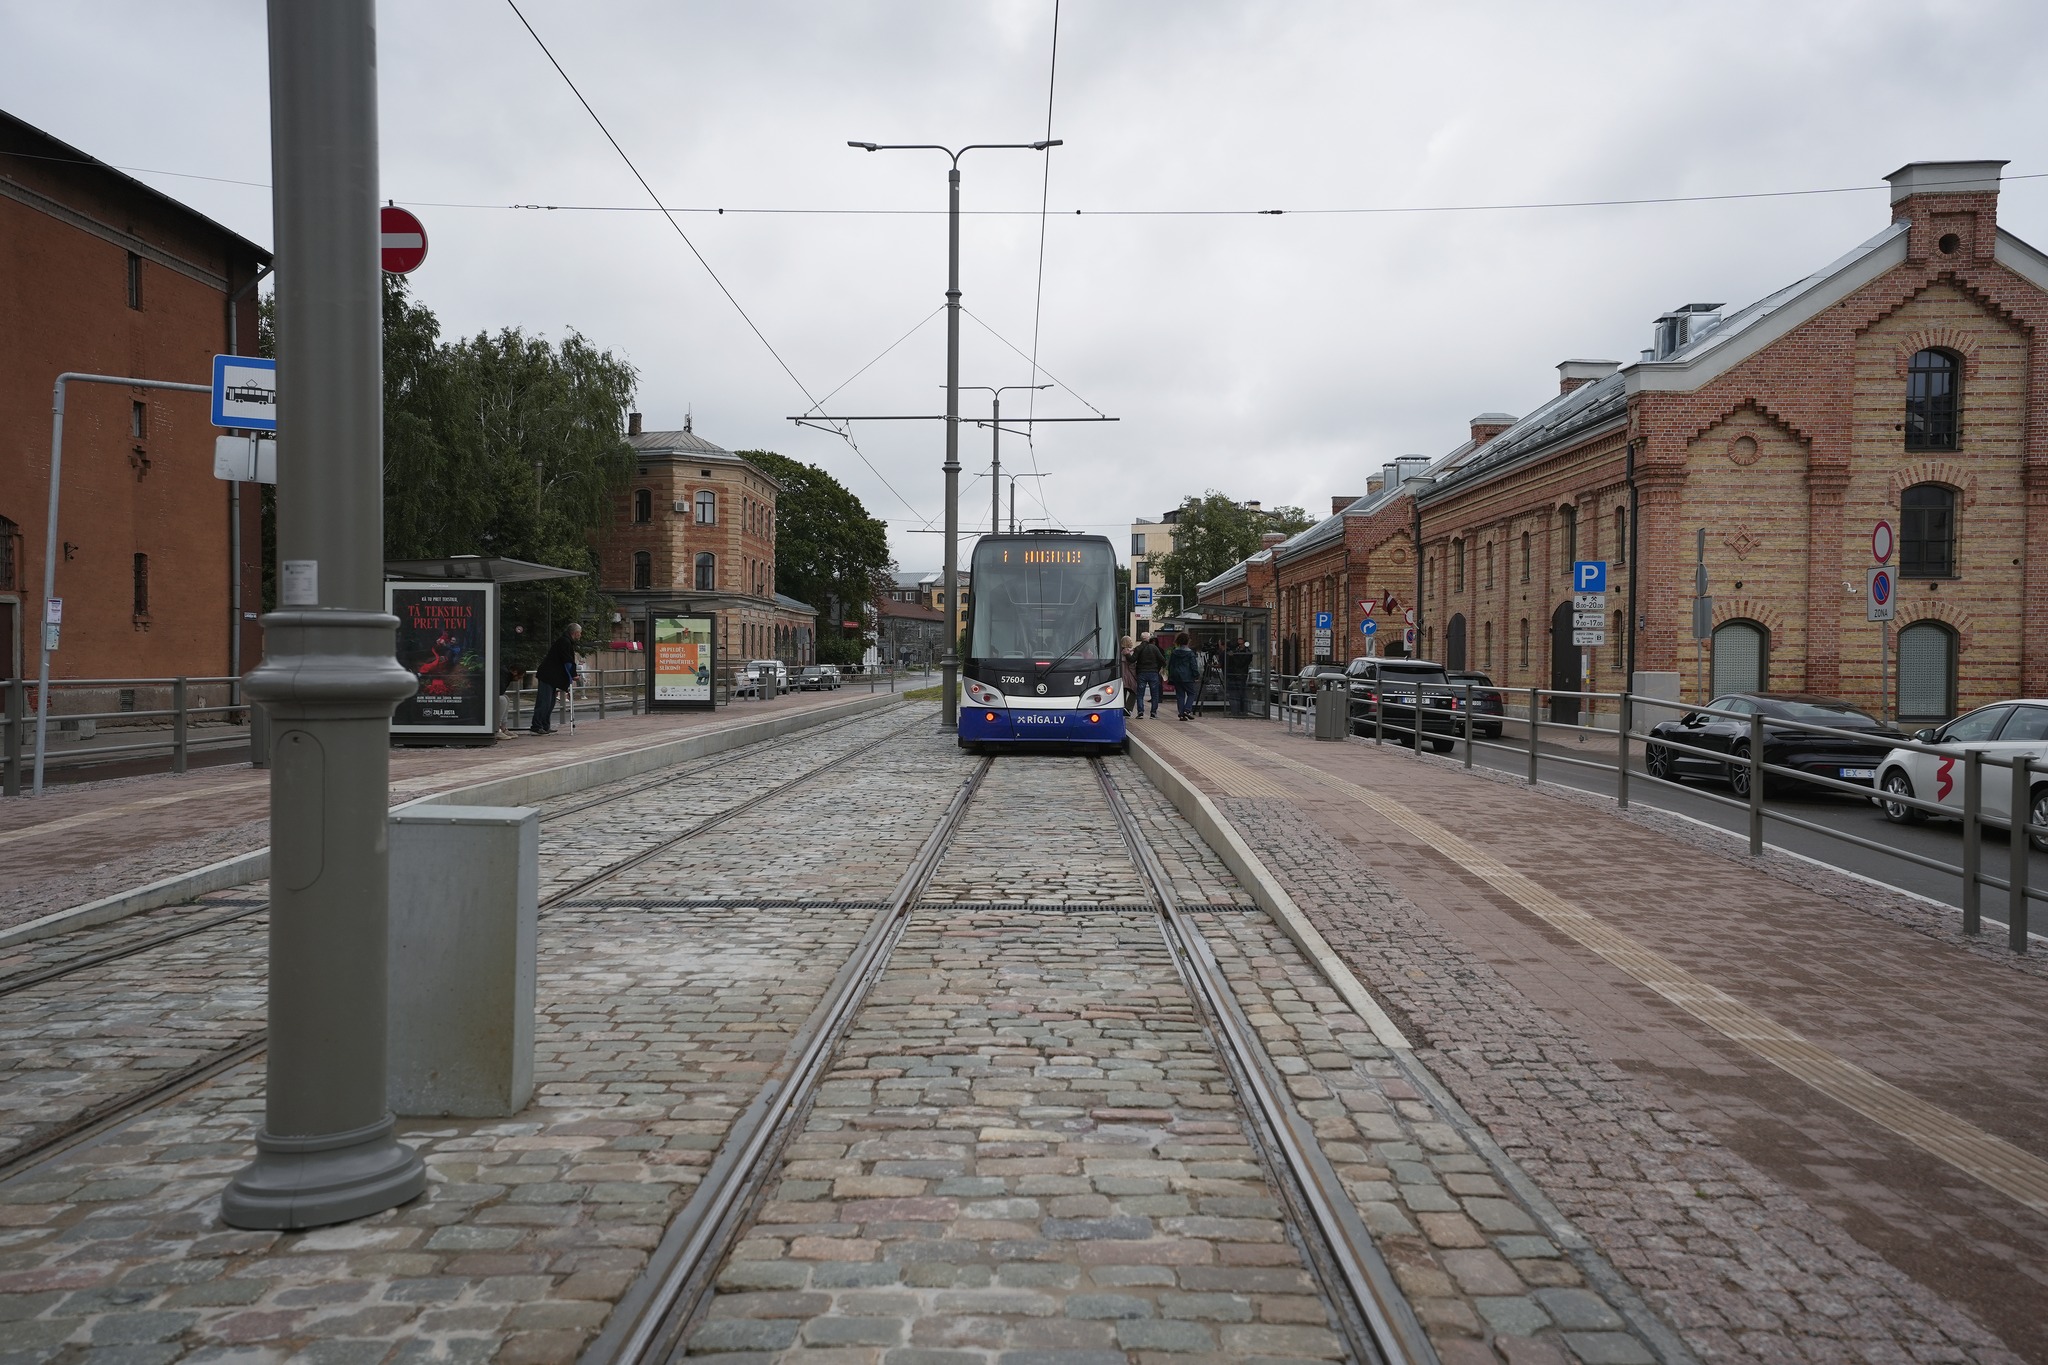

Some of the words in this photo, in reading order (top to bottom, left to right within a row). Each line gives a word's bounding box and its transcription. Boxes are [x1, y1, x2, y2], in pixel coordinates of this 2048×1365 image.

[1581, 565, 1599, 588] P
[408, 604, 420, 616] TĀ
[425, 606, 472, 617] TEKSTILS
[1874, 609, 1888, 617] ZONA
[414, 618, 440, 629] PRET
[444, 618, 466, 629] TEVI
[1319, 615, 1328, 626] P
[1027, 715, 1065, 724] RĪGA.LV
